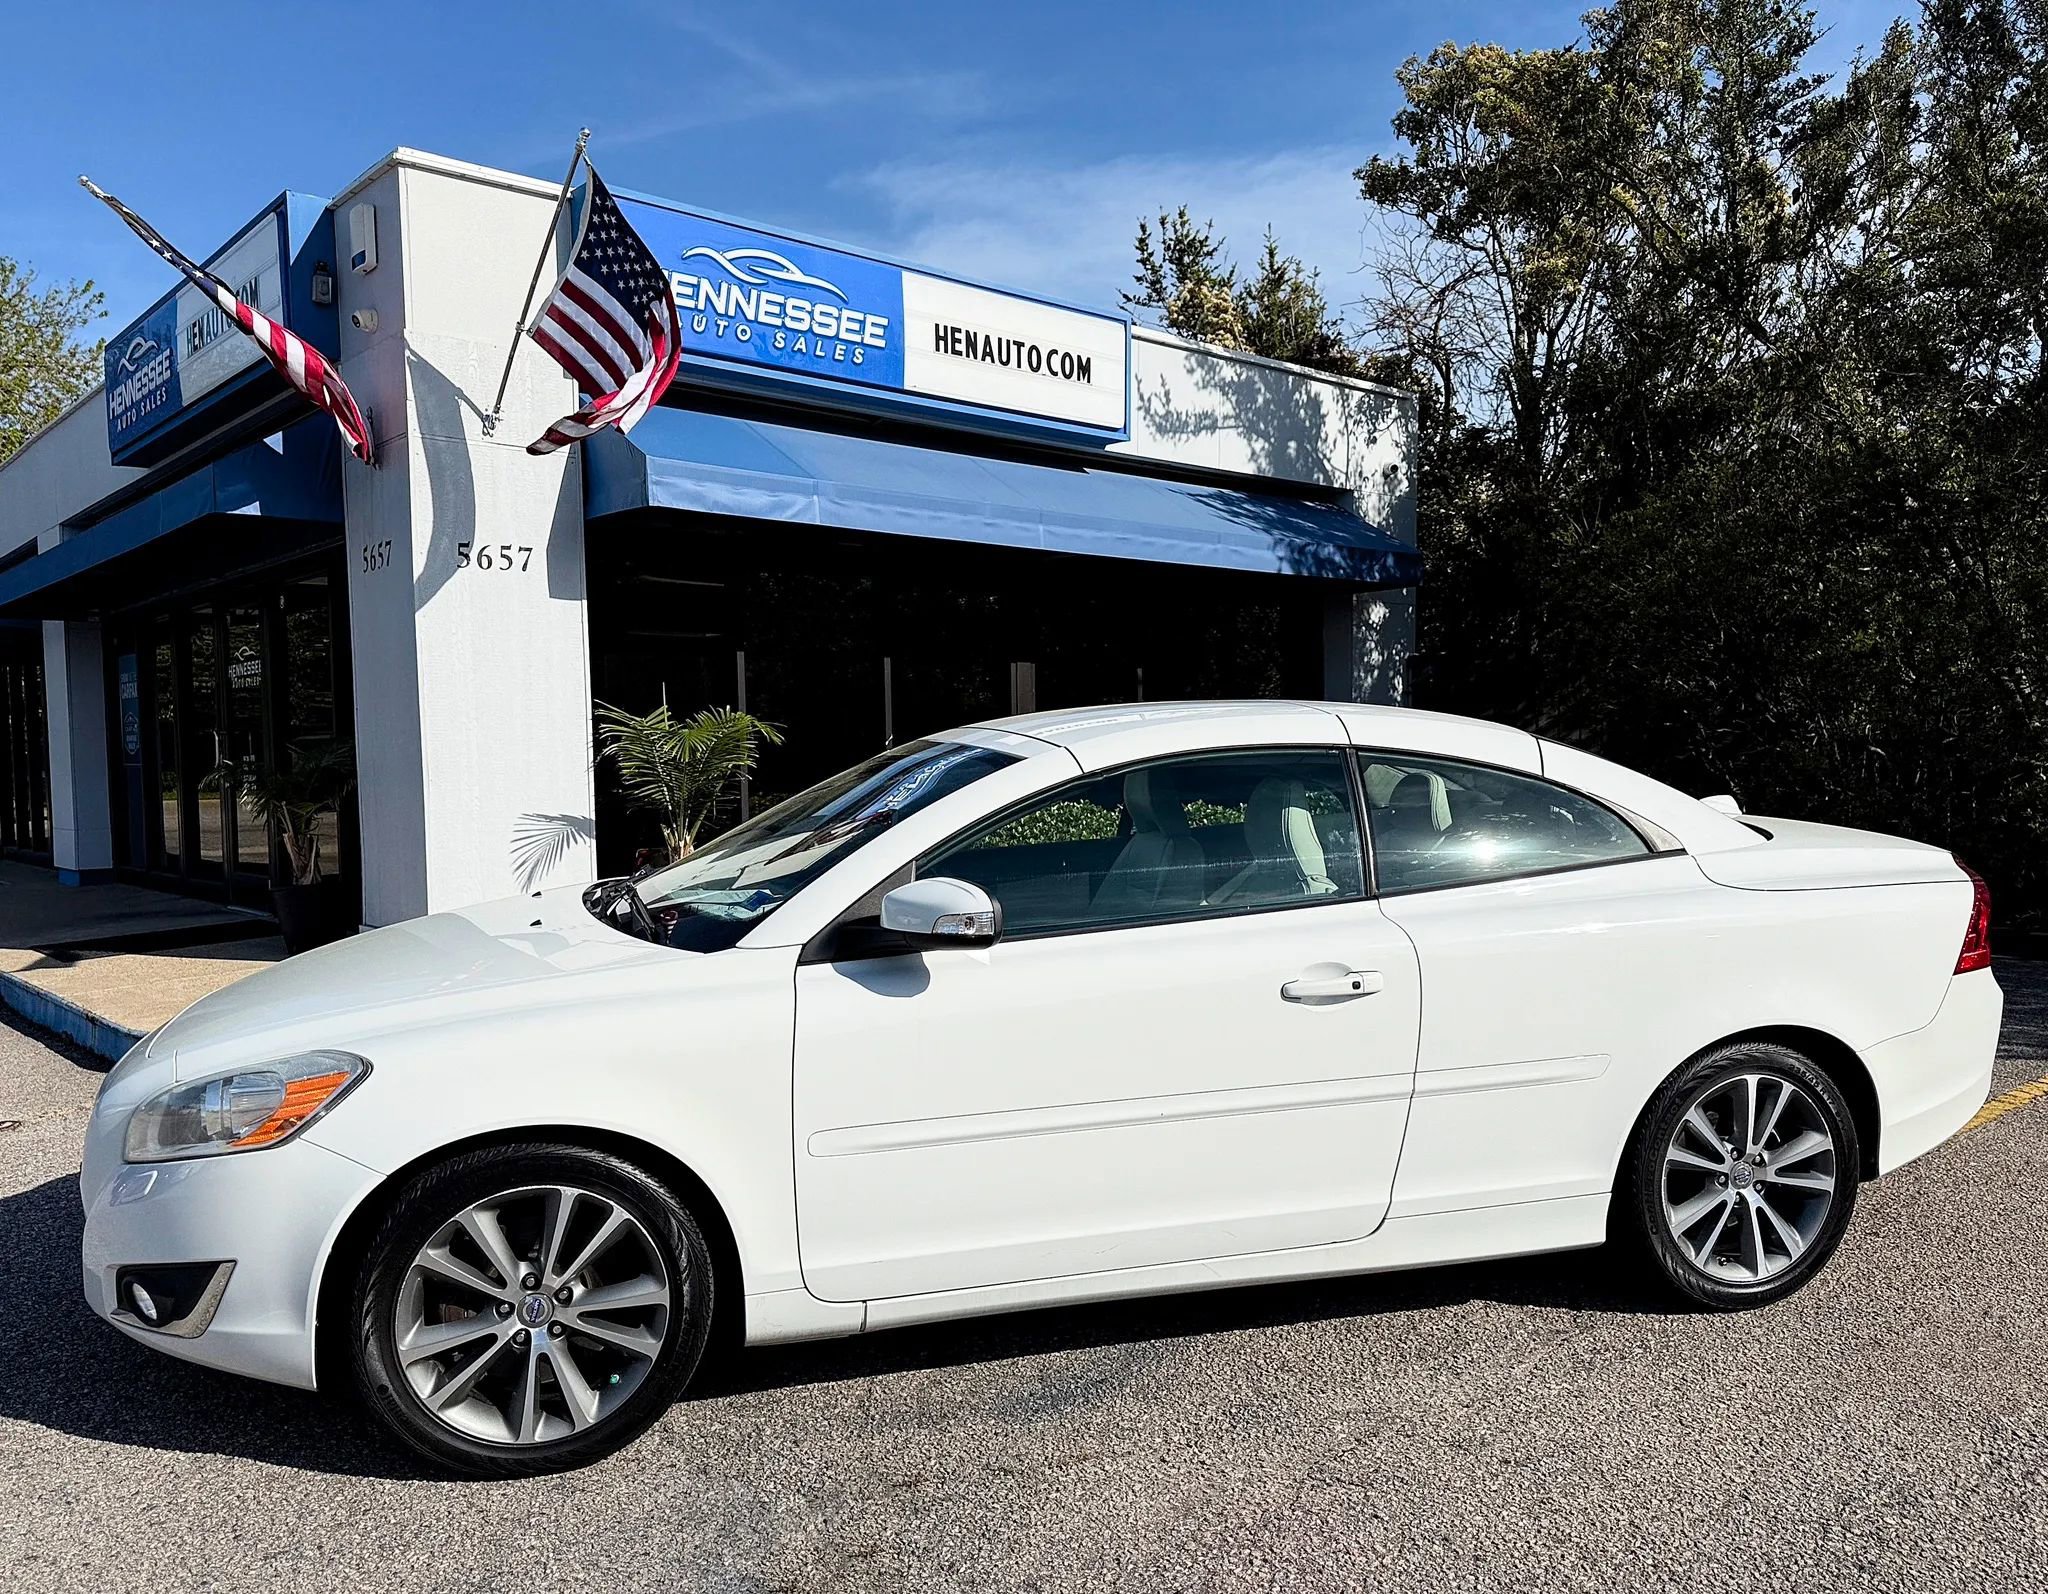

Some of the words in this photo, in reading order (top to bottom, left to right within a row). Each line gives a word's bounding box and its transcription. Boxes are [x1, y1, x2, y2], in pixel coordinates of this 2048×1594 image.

[661, 268, 889, 348] ENNESSEE
[678, 311, 752, 342] UTO
[773, 330, 865, 364] SALES
[109, 348, 171, 420] HENNESSEE
[117, 407, 137, 433] AUTO
[140, 387, 167, 417] SALES
[363, 540, 392, 573] 5657
[456, 541, 533, 572] 5657
